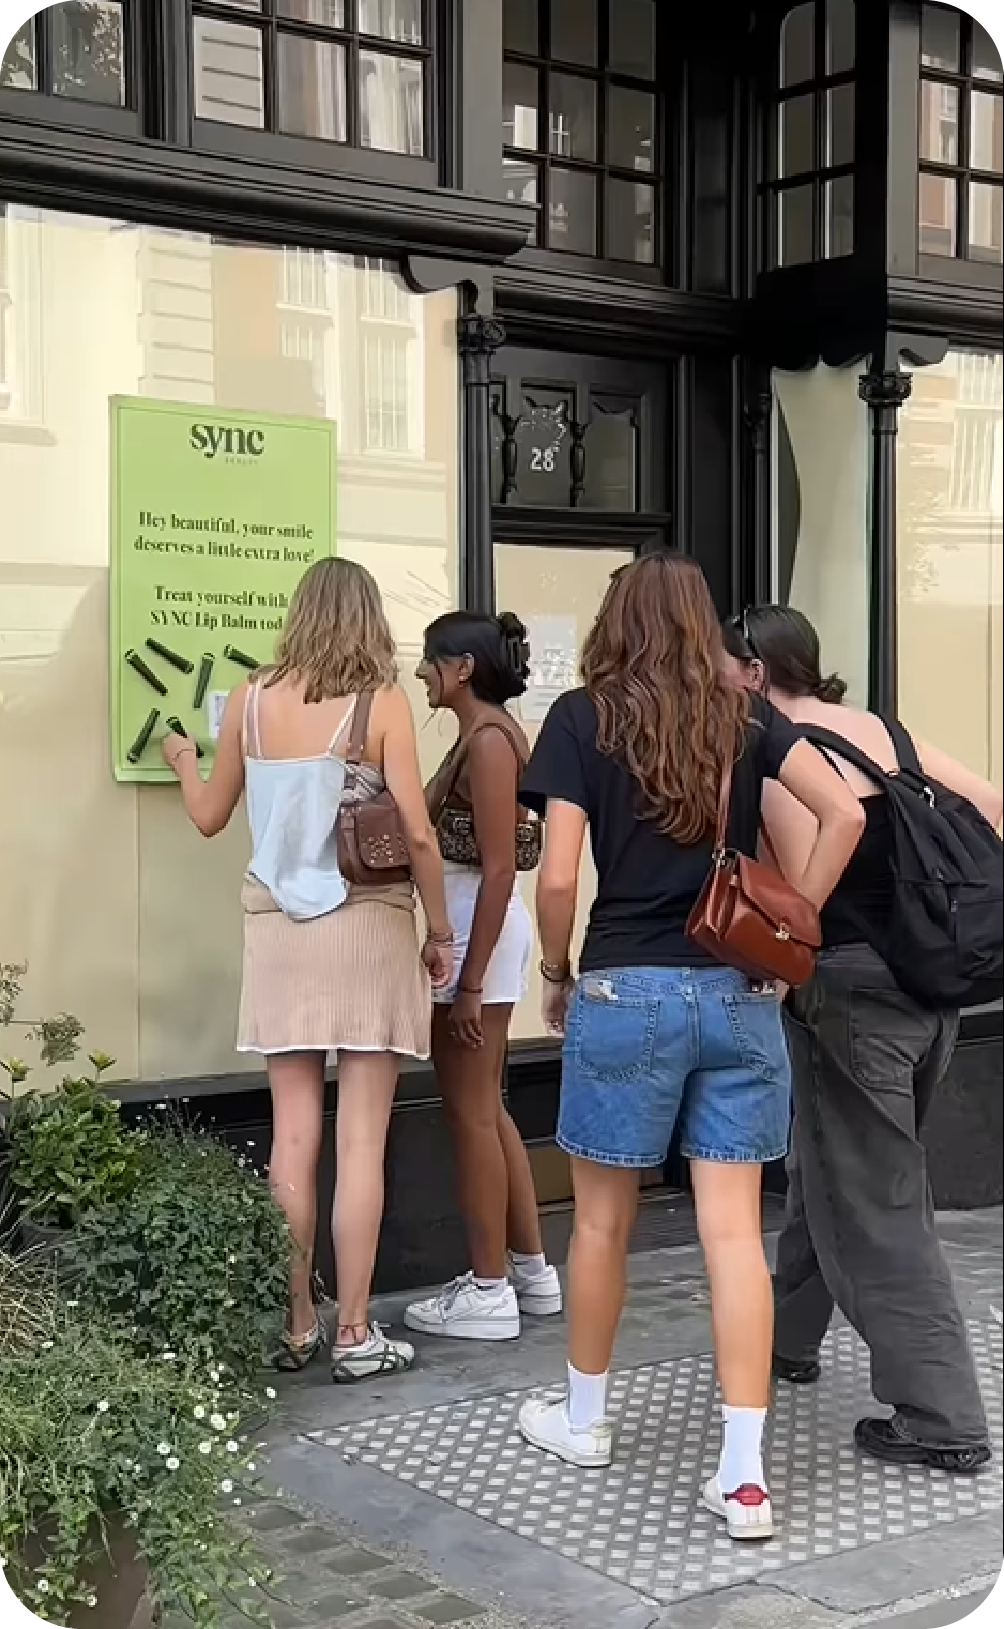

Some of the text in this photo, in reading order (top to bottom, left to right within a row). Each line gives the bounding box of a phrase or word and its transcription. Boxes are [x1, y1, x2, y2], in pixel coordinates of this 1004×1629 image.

[190, 424, 264, 458] sync
[530, 446, 554, 472] 28
[139, 511, 314, 540] Hey beautiful, your smile
[134, 535, 195, 554] deserves
[195, 543, 205, 555] a
[208, 541, 242, 558] little
[244, 547, 280, 561] extra
[153, 585, 289, 607] Treat yourself with
[150, 609, 284, 631] SYNC Lip Balm tod
